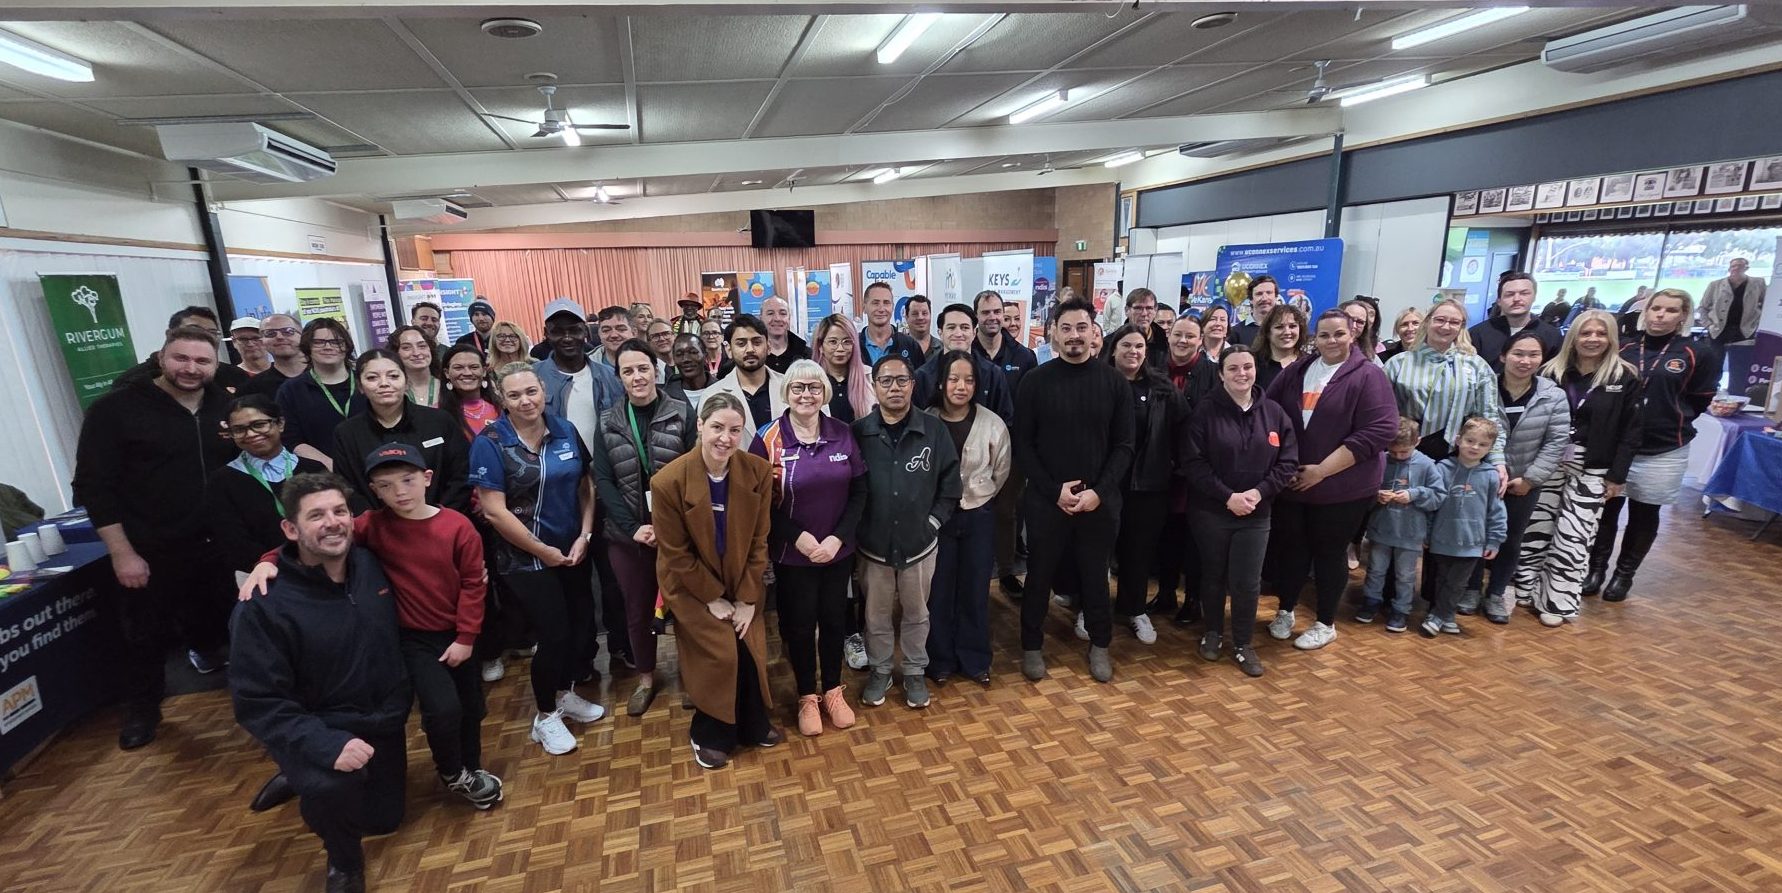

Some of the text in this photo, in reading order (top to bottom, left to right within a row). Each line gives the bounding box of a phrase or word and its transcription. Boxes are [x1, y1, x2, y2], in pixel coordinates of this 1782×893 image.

[866, 269, 896, 283] Capable
[988, 273, 1010, 286] KEYS
[65, 327, 126, 344] RIVERGUM
[22, 605, 53, 631] out
[0, 643, 30, 673] you
[31, 622, 62, 650] find
[2, 684, 36, 713] APM
